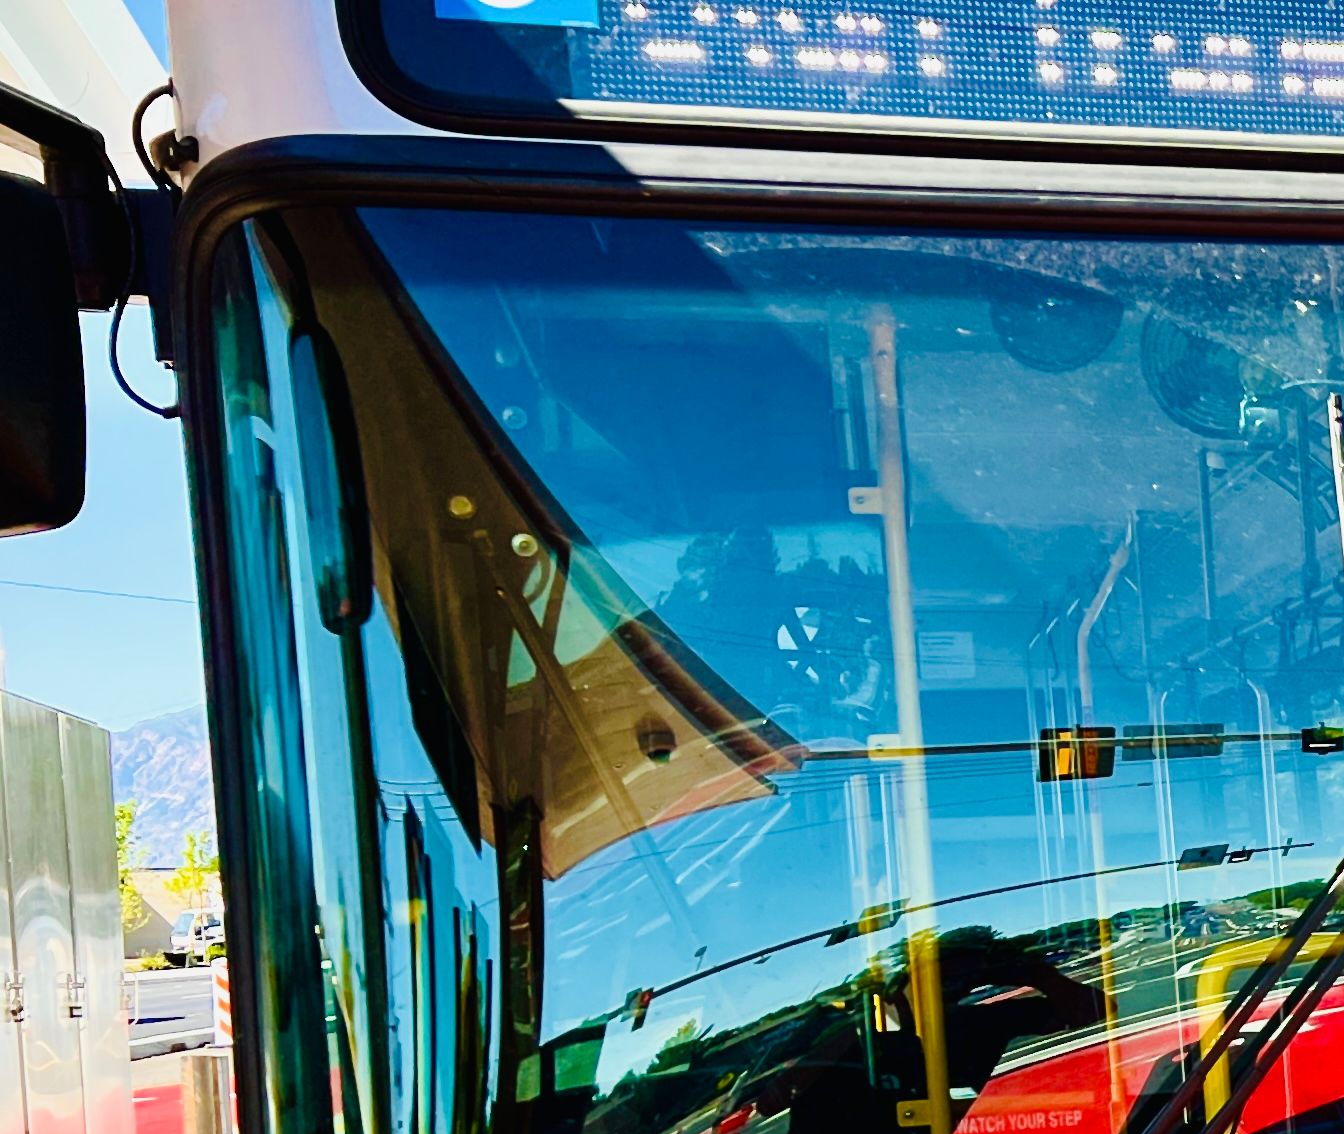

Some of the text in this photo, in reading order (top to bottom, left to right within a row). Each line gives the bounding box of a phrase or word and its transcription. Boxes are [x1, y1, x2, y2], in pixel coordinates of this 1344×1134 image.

[957, 1110, 1083, 1134] WATCH YOUR STEP
